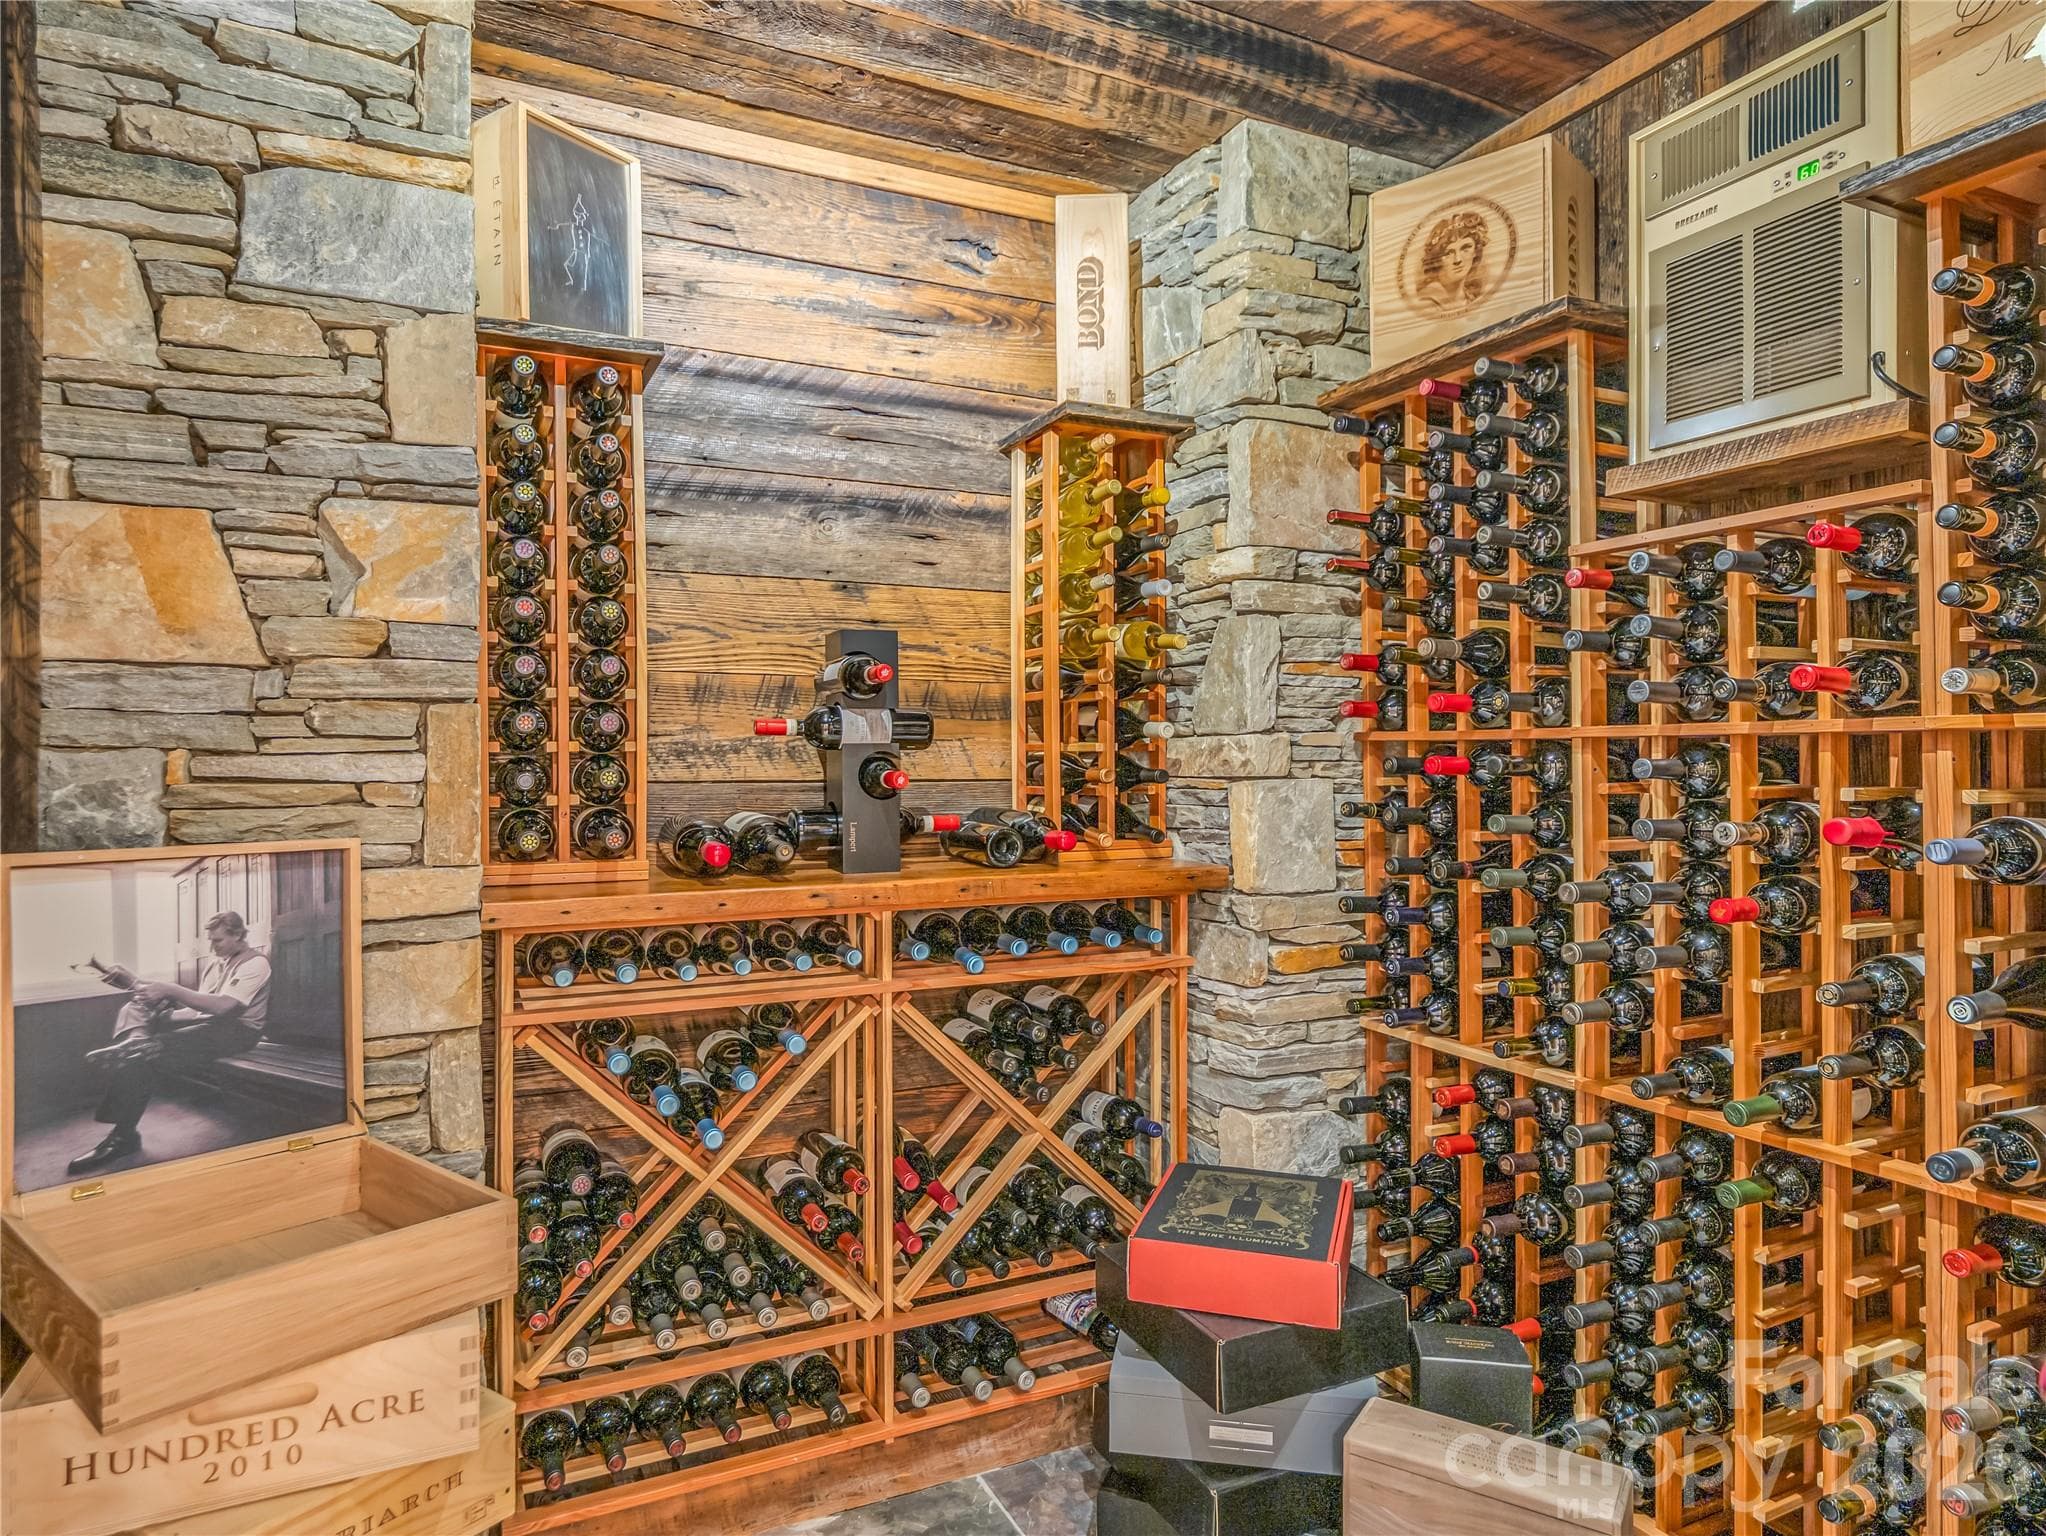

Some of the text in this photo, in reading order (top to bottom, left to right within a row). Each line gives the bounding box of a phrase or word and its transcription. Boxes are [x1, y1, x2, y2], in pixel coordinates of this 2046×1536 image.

[1800, 162, 1819, 180] 60
[1077, 256, 1105, 350] BOND
[1198, 1231, 1225, 1239] WINE
[1228, 1235, 1290, 1247] ILLUMINATI
[62, 1388, 426, 1487] HUNDRED ACRE
[203, 1442, 303, 1486] 2010
